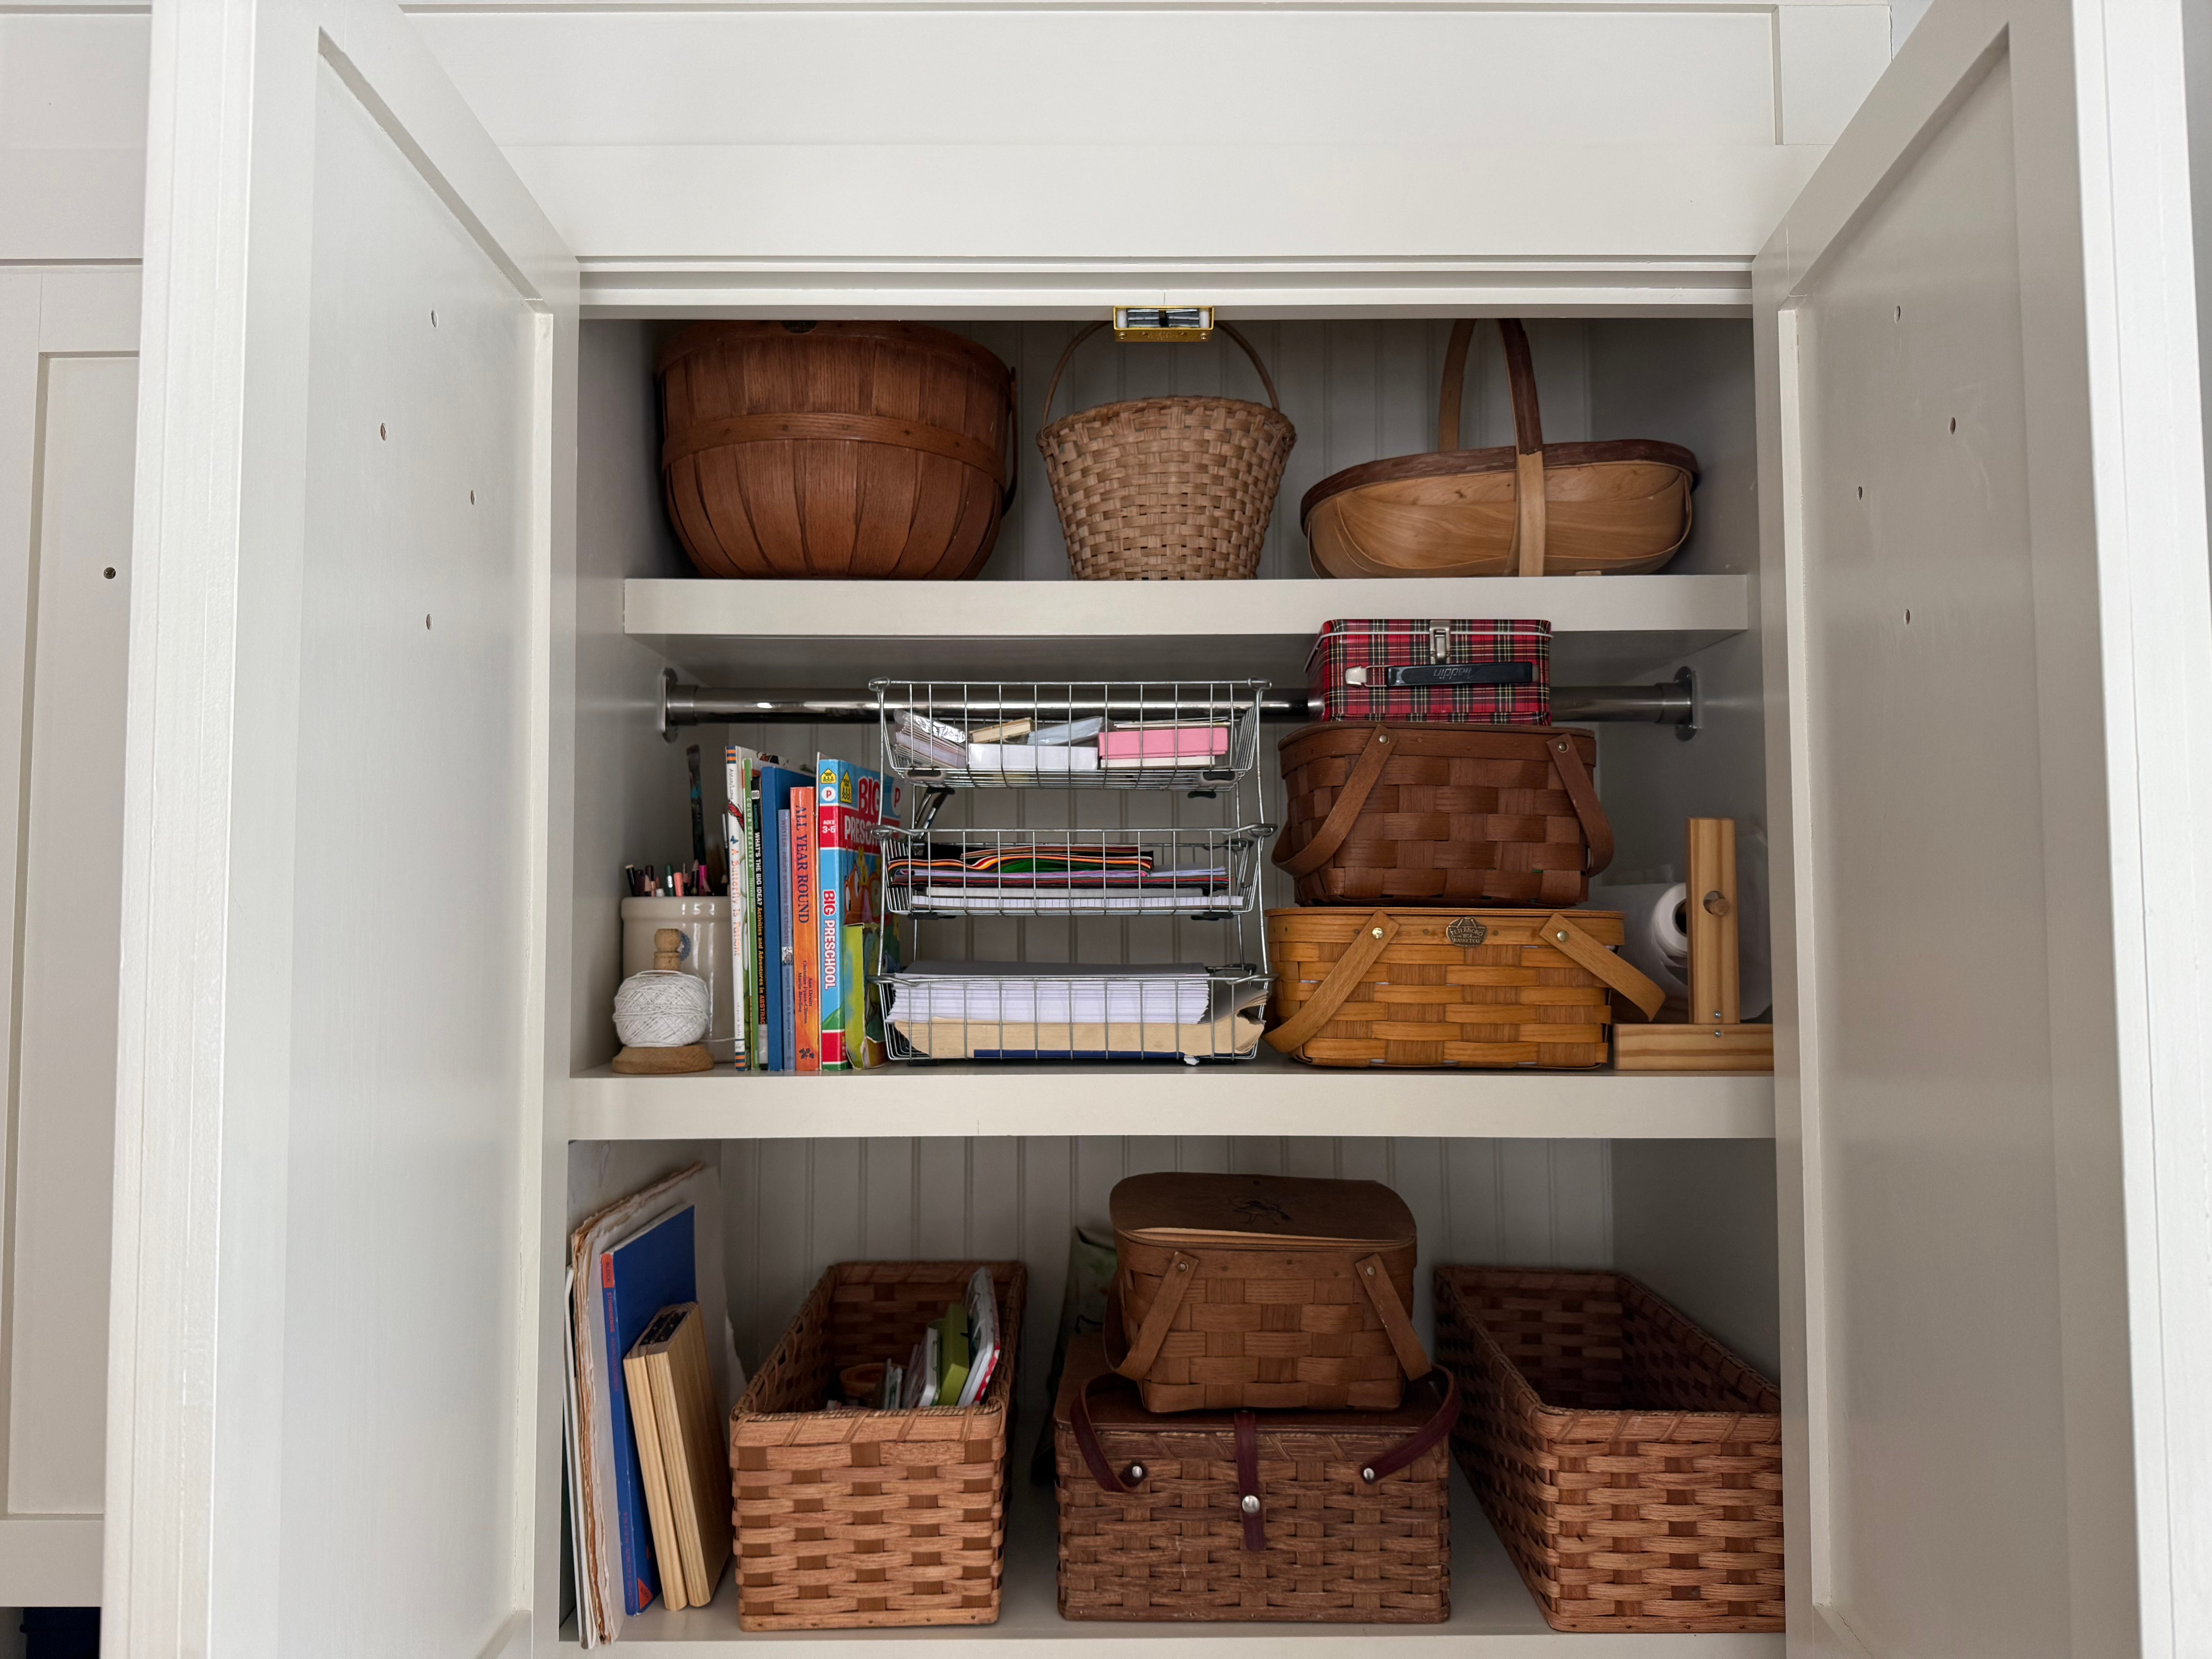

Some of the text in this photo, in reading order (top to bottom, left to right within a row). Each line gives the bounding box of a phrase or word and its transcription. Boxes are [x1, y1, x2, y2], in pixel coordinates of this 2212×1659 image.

[826, 790, 832, 798] P
[858, 776, 881, 815] BIG
[894, 787, 901, 808] P
[732, 860, 741, 904] Butterfly
[796, 805, 809, 924] ALL YEAR ROUND
[823, 890, 836, 990] BIG PRESCHOOL
